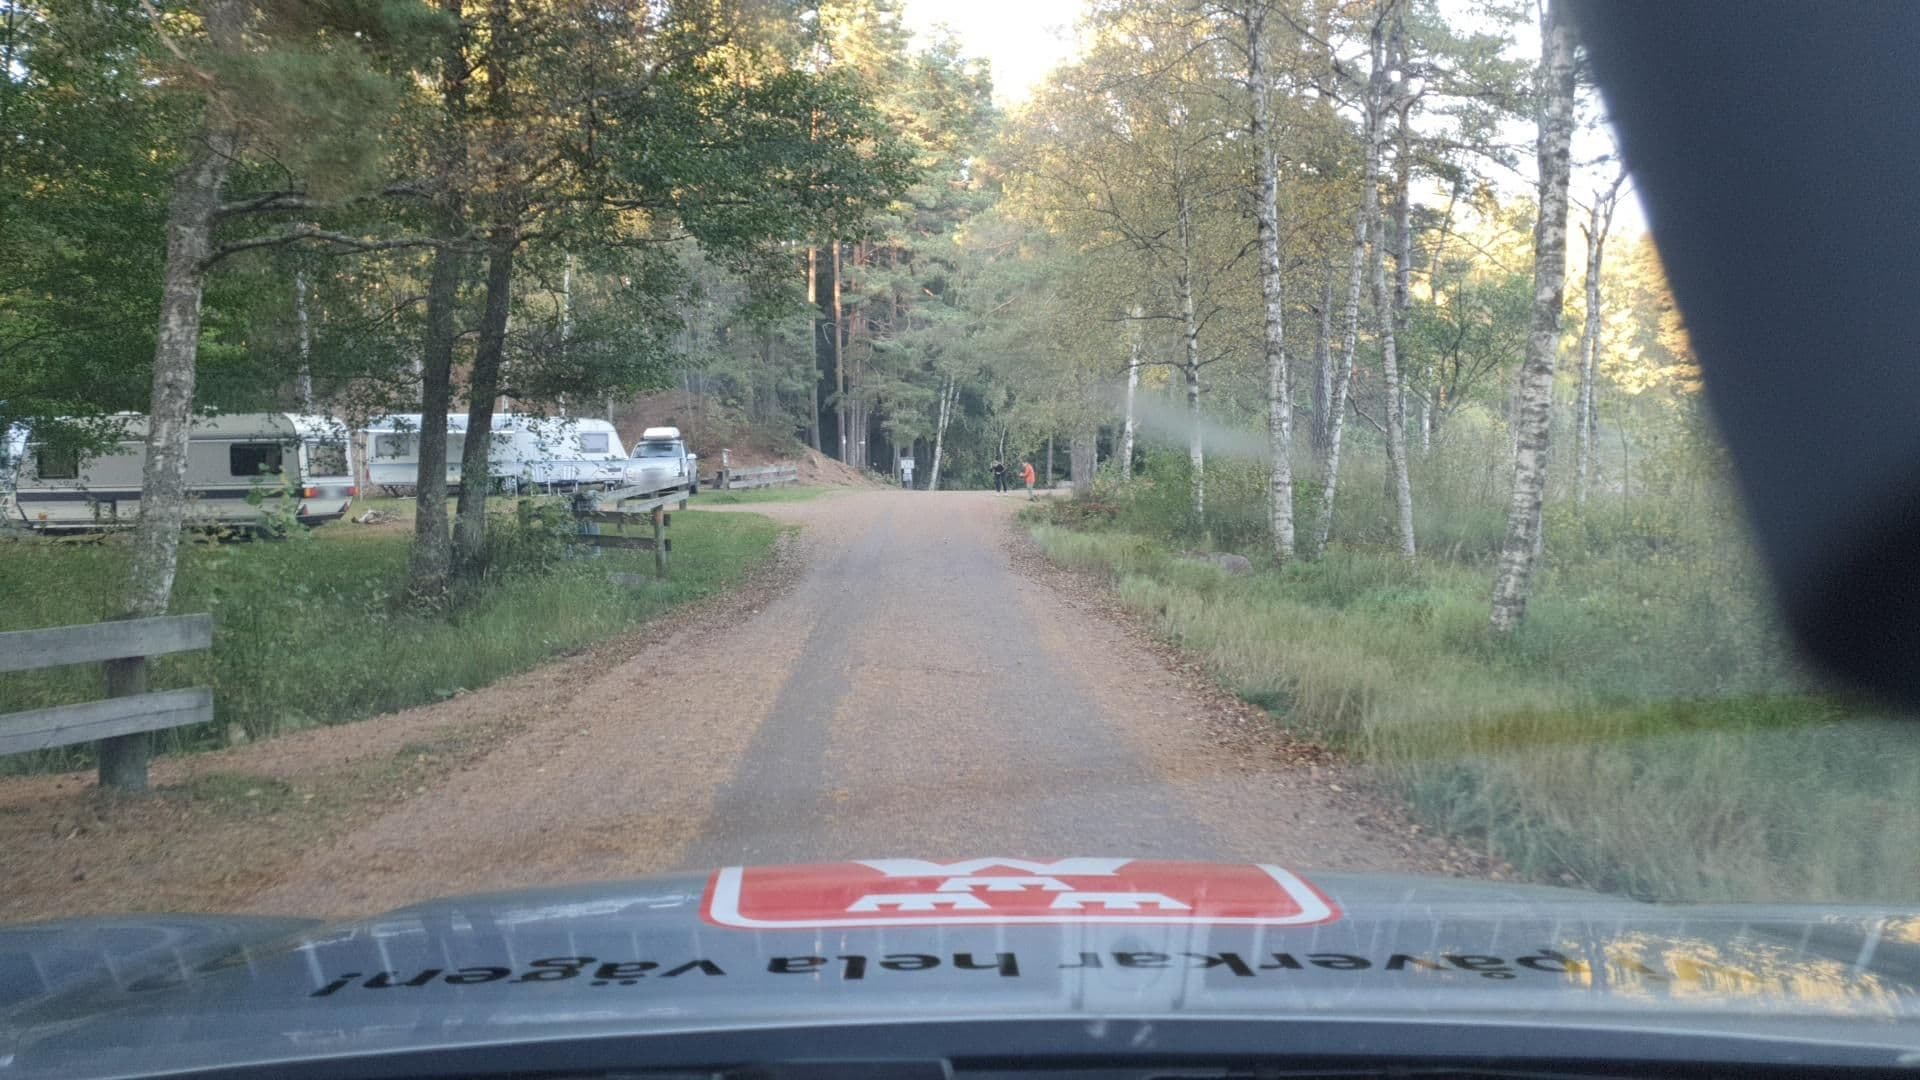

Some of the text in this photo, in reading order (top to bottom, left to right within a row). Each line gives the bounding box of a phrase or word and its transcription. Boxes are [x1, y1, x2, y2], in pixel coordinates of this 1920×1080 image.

[309, 957, 726, 997] vägen!
[766, 952, 1020, 979] hela
[1057, 949, 1592, 980] påverkar
